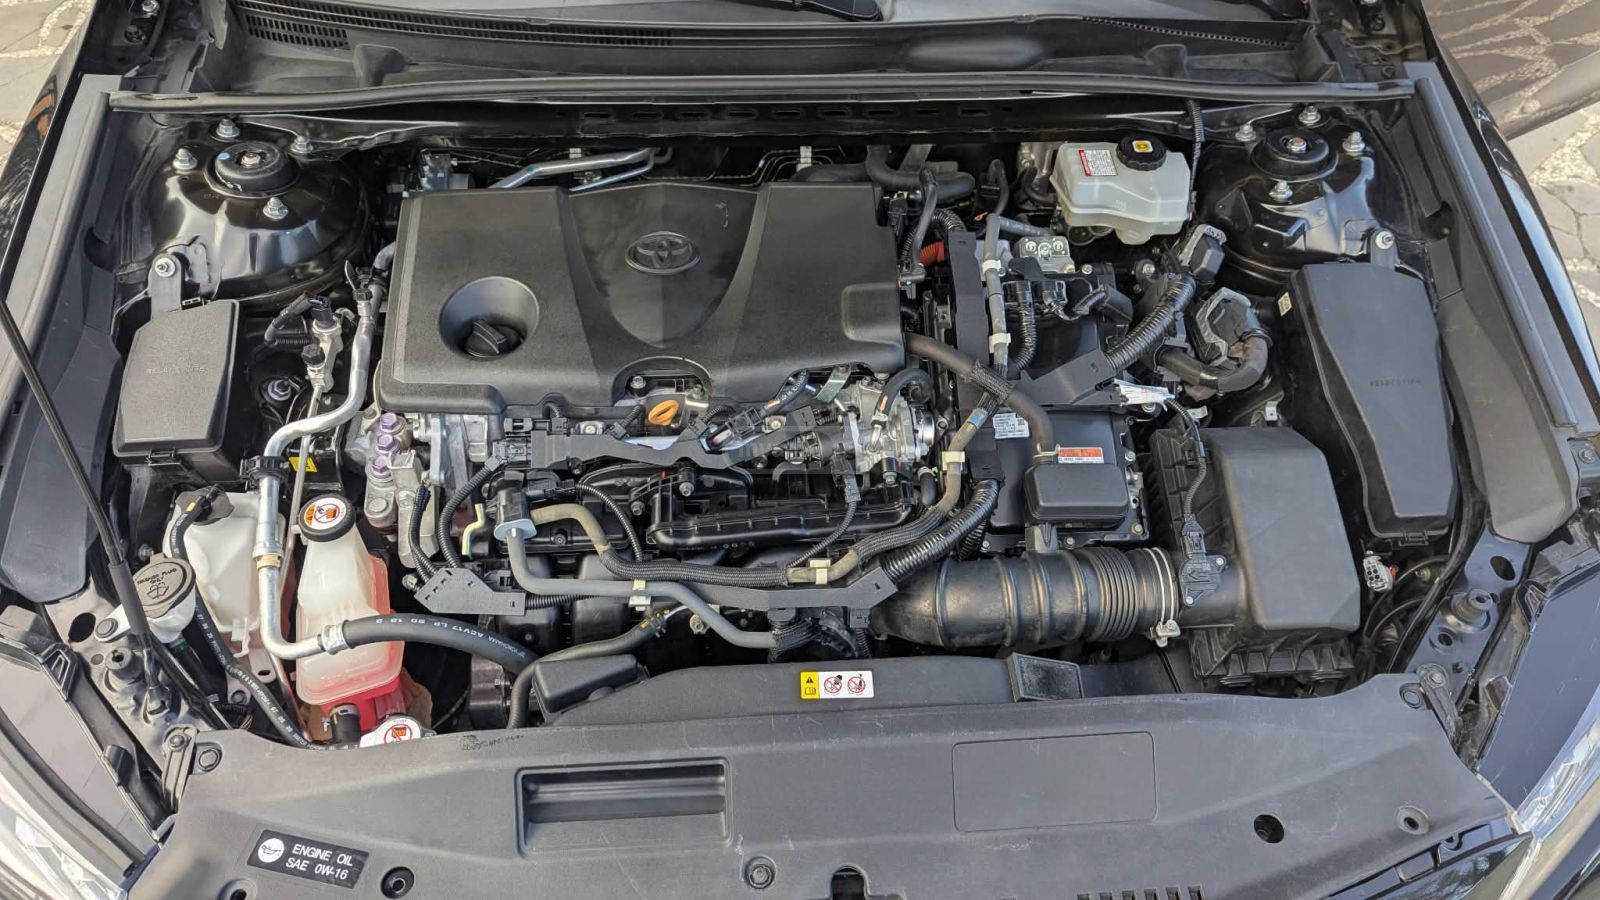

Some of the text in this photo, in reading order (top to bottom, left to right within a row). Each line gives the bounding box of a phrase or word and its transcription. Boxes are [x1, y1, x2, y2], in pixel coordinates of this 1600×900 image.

[488, 635, 518, 655] YOKOHAMA
[292, 843, 353, 866] ENGINE OIL
[285, 857, 349, 880] SAE 0W-16
